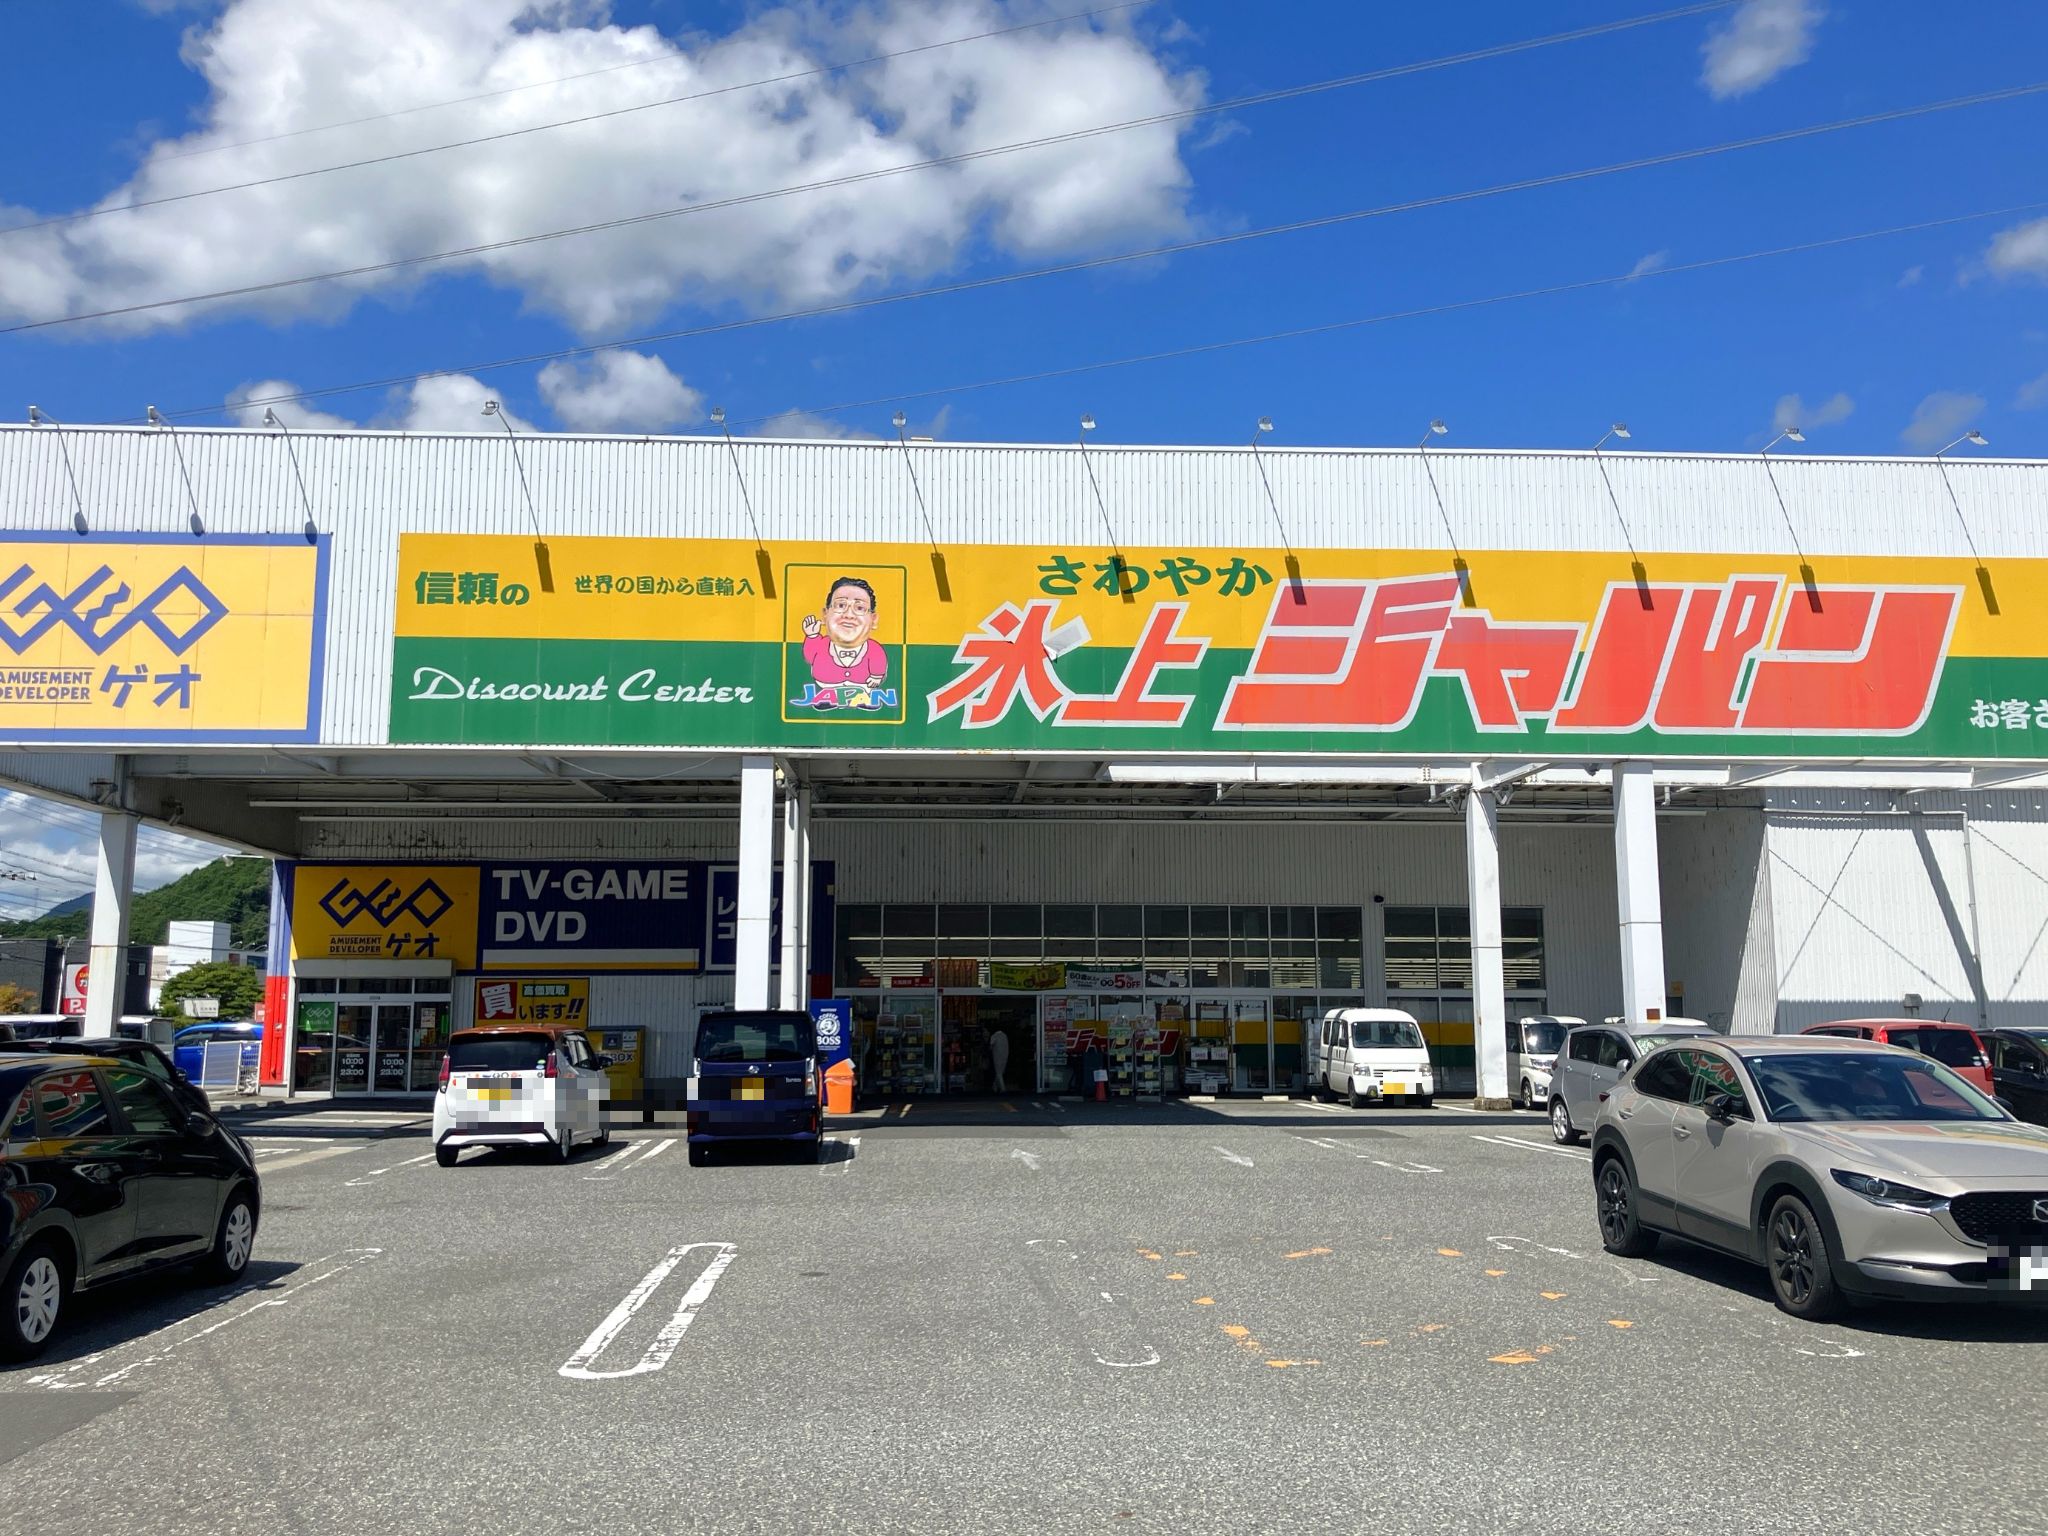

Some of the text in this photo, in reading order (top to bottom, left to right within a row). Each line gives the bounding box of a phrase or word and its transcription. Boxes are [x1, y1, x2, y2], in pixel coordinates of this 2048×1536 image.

[414, 571, 529, 606] 信頼の
[575, 574, 755, 597] 世界の国から直輸入
[1038, 555, 1273, 597] さわやか
[99, 663, 201, 709] ゲオ
[408, 667, 754, 704] Discount Center
[790, 684, 899, 708] JAPAN
[492, 869, 689, 900] TV-GAME
[319, 878, 455, 929] GEO
[495, 911, 587, 942] DVD
[330, 936, 382, 945] AMUSEMENT
[330, 945, 381, 953] DEVELOPER
[386, 932, 440, 958] ゲオ
[524, 985, 566, 996] 高価買取
[69, 1001, 80, 1013] P
[816, 1036, 841, 1046] BOSS
